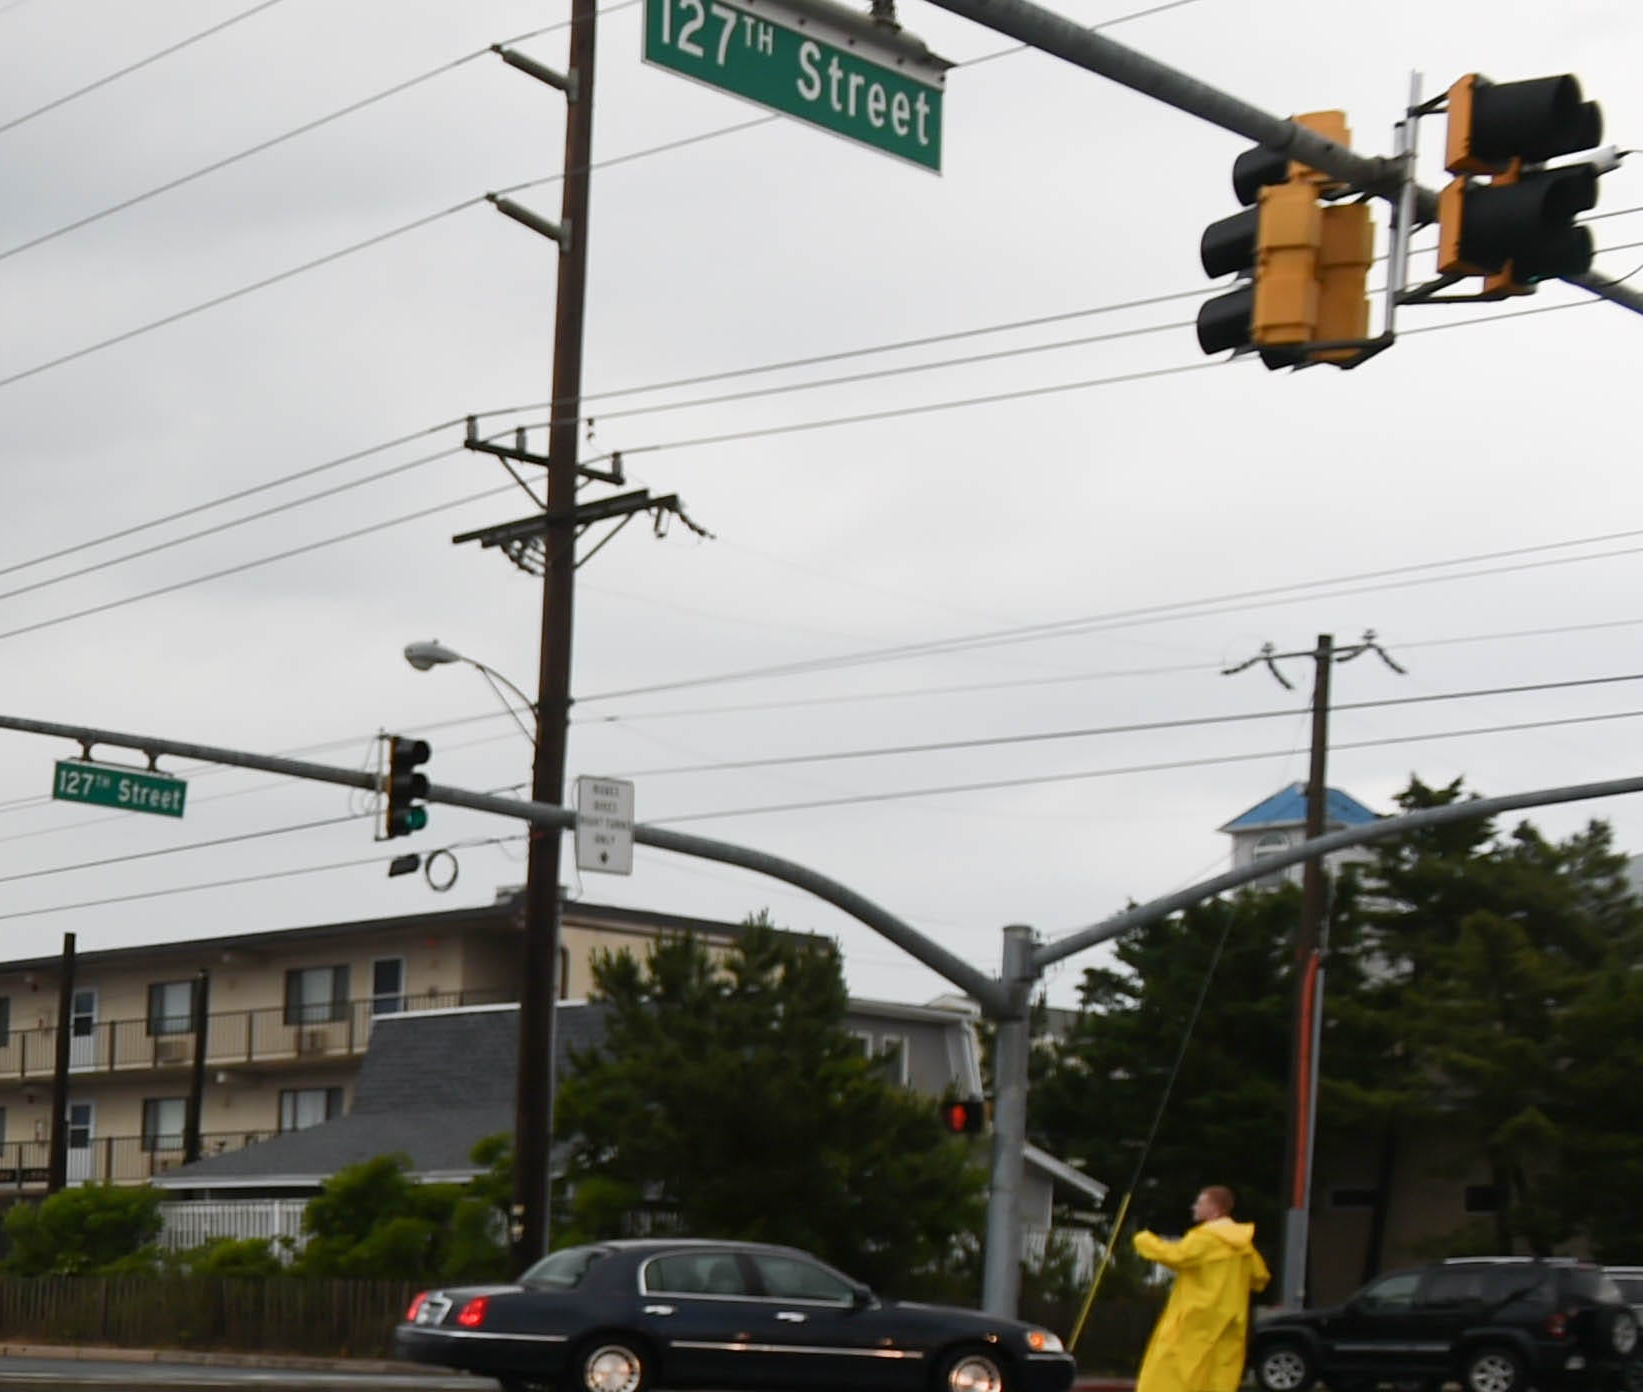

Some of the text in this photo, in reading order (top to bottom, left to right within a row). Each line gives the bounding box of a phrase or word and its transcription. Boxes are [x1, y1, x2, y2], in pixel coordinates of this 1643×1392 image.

[660, 0, 930, 145] 127TH Street
[59, 770, 182, 810] 127TH Street
